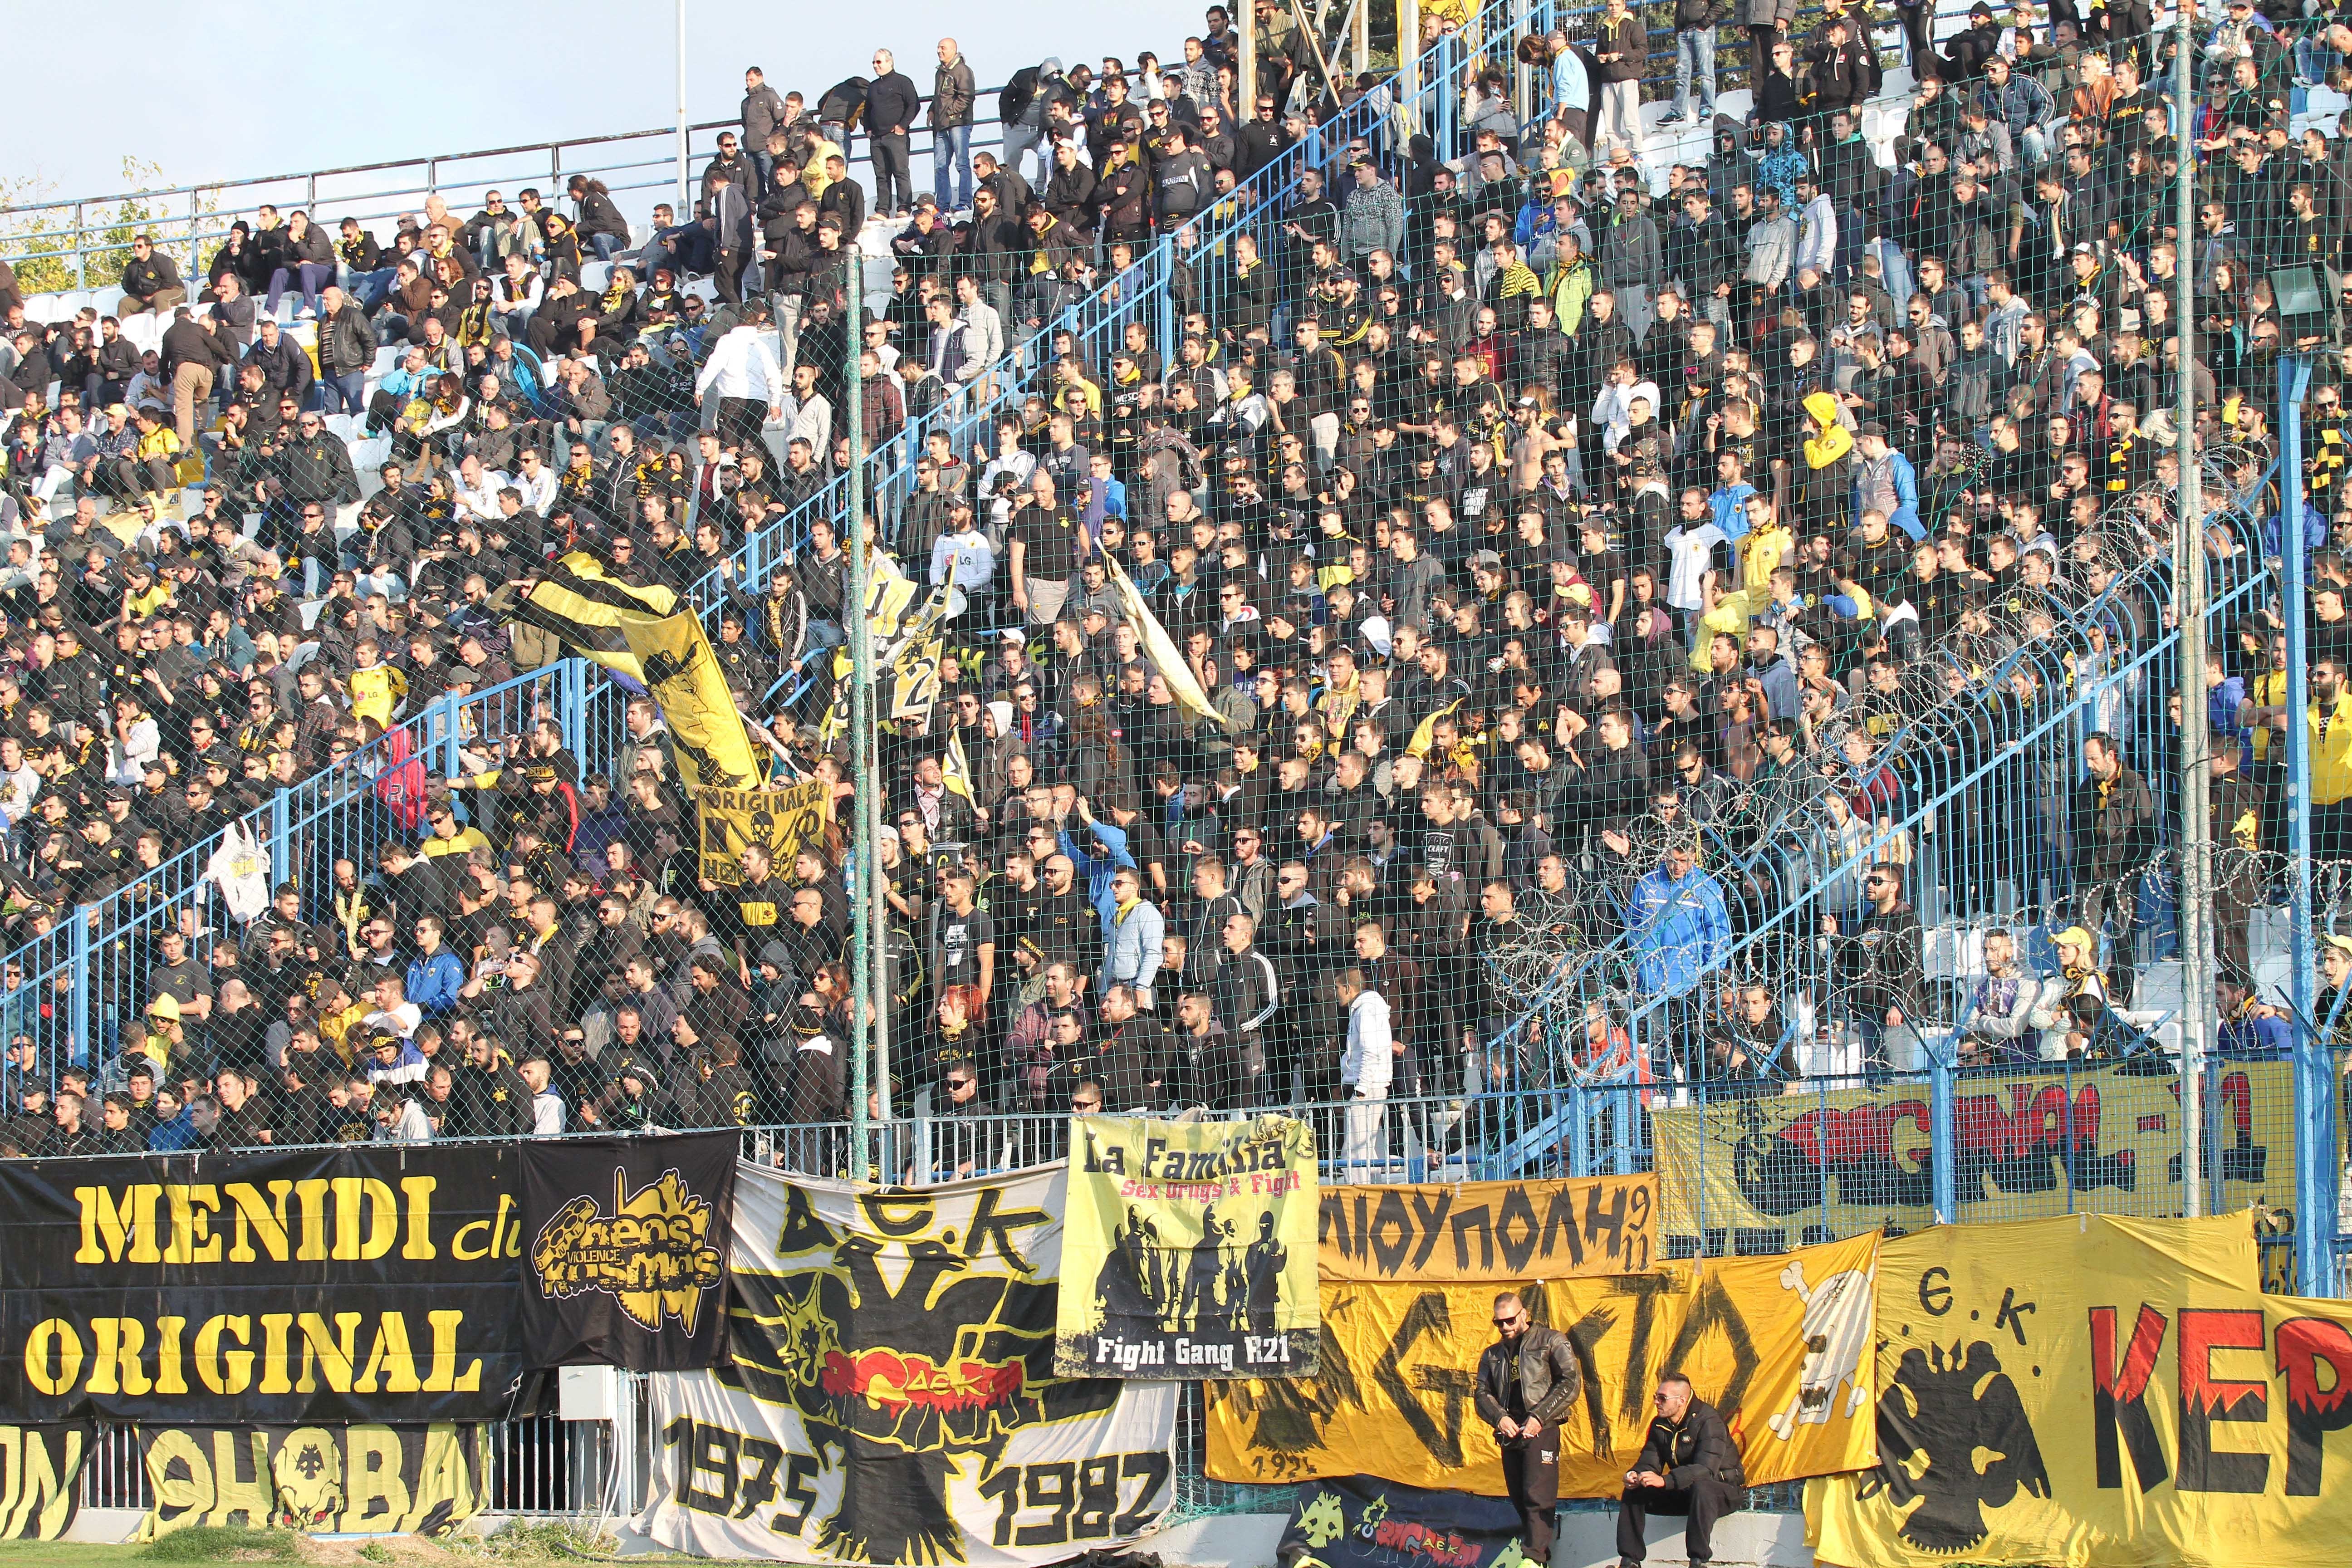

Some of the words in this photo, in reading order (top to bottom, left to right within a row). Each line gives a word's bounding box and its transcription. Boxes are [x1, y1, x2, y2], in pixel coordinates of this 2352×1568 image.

[1463, 497, 1486, 506] ODERN
[960, 556, 971, 566] LG
[703, 787, 805, 814] ORIGINAL
[1083, 1132, 1125, 1177] La
[1143, 1134, 1286, 1181] Familia
[1121, 1180, 1158, 1200] Sex
[1166, 1181, 1221, 1204] Drugs
[1229, 1182, 1242, 1197] &
[1251, 1170, 1300, 1197] Fight
[75, 1176, 436, 1264] MENIDI
[24, 1310, 482, 1396] ORIGINAL
[1096, 1334, 1165, 1372] Fight
[1175, 1338, 1235, 1372] Gang
[1244, 1334, 1290, 1364] R21
[662, 1414, 824, 1538] 1975
